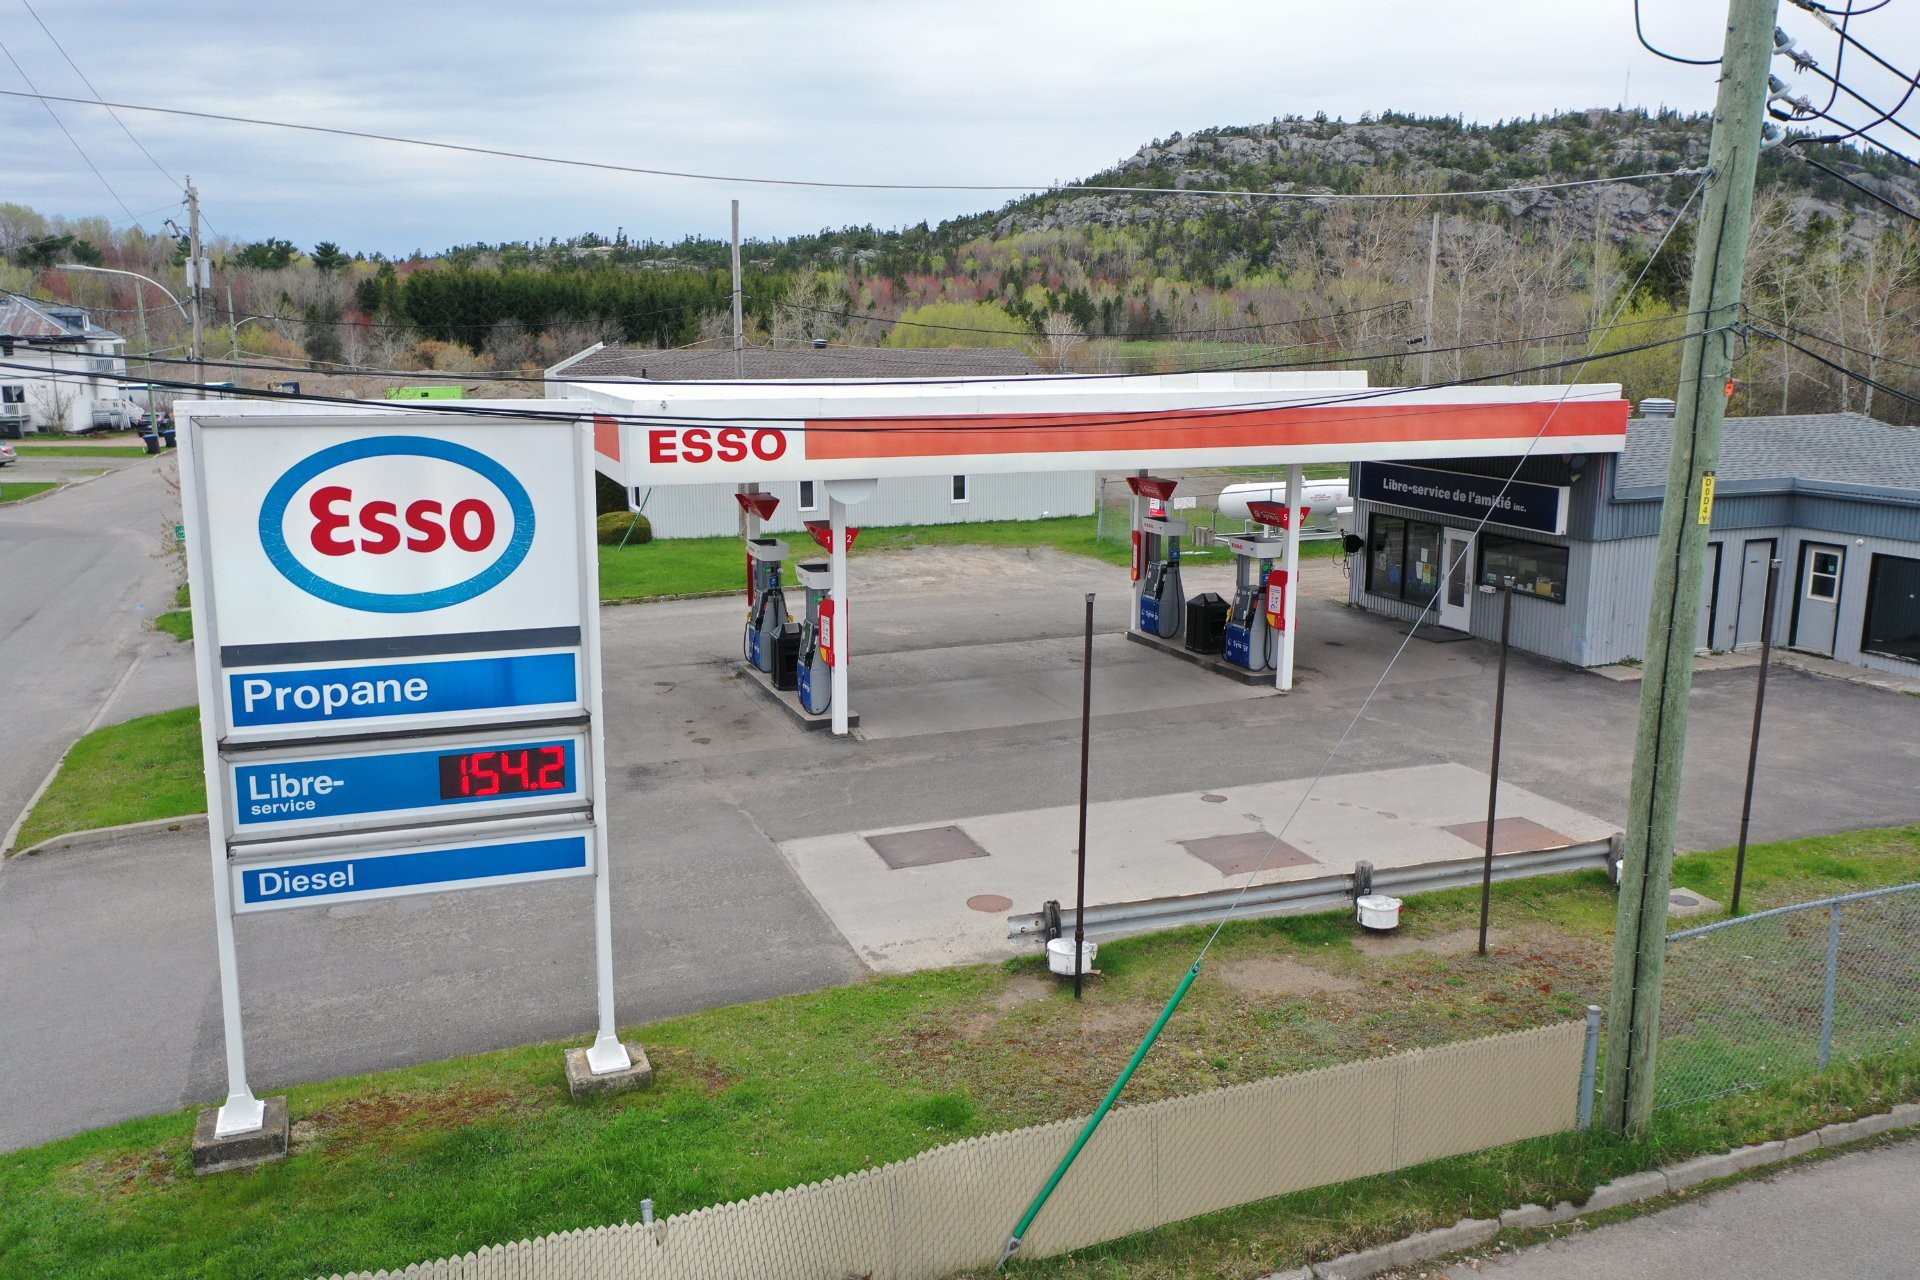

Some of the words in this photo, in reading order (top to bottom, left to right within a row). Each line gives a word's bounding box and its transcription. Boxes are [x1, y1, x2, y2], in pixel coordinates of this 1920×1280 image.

[649, 428, 787, 463] ESSO
[1383, 477, 1450, 500] Libre-service
[1452, 489, 1466, 502] de
[1468, 491, 1511, 510] l'amitié
[1513, 502, 1527, 513] inc.
[309, 486, 495, 557] Esso
[1283, 513, 1288, 521] 5
[1300, 512, 1305, 520] 6
[826, 536, 831, 544] 1
[846, 534, 852, 543] 2
[243, 677, 428, 715] Propane
[460, 745, 565, 796] 154.2
[249, 773, 344, 801] Libre-
[251, 799, 316, 816] service
[258, 864, 355, 896] Diesel
